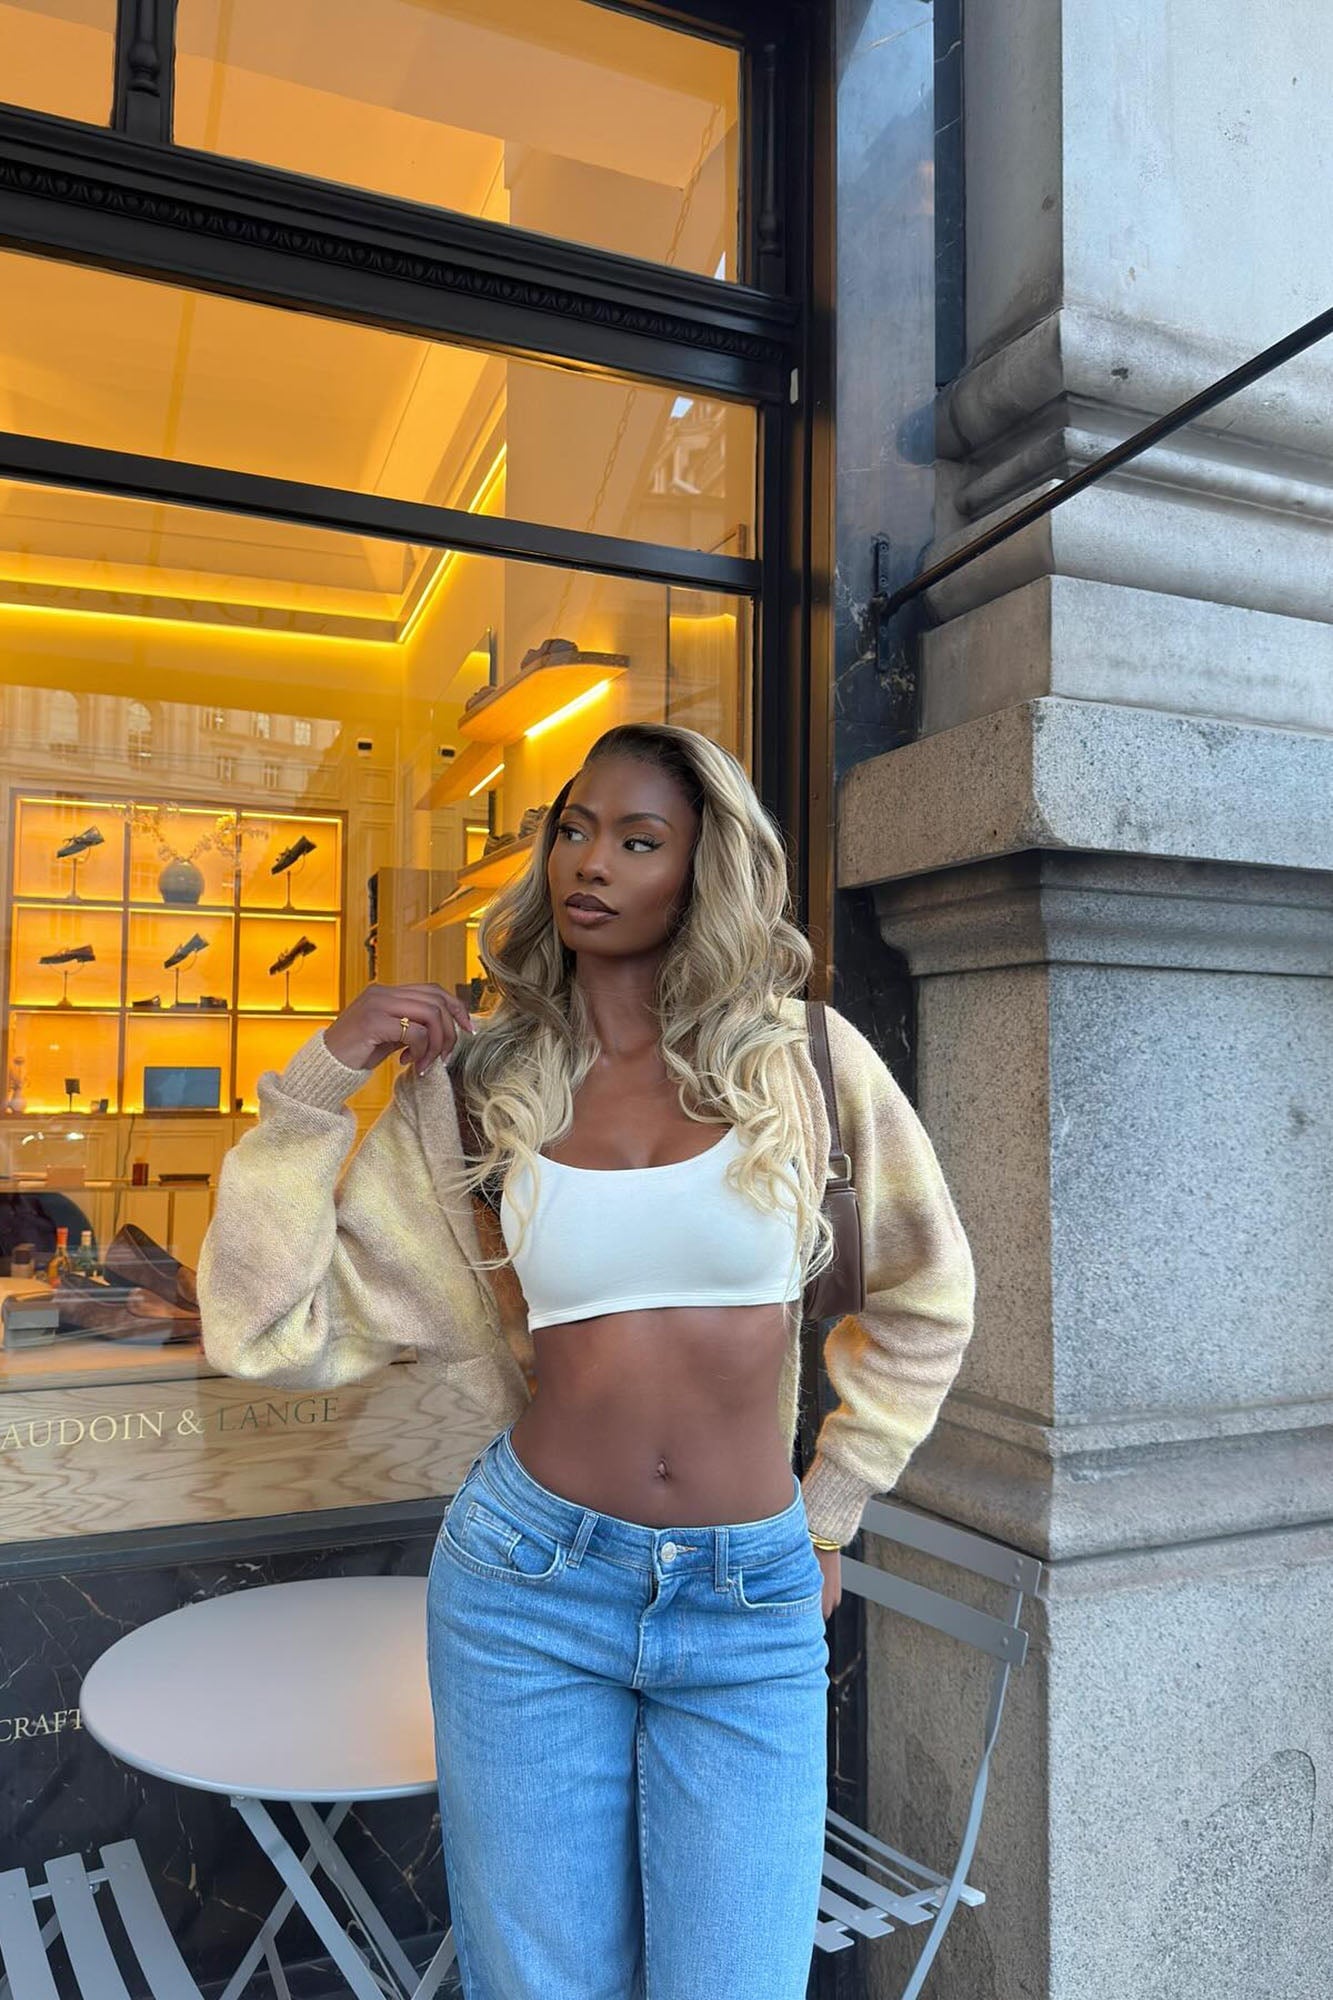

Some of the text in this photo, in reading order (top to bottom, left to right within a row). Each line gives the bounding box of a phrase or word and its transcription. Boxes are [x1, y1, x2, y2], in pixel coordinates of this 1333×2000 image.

[1, 1397, 338, 1450] AUDOIN & LANGE
